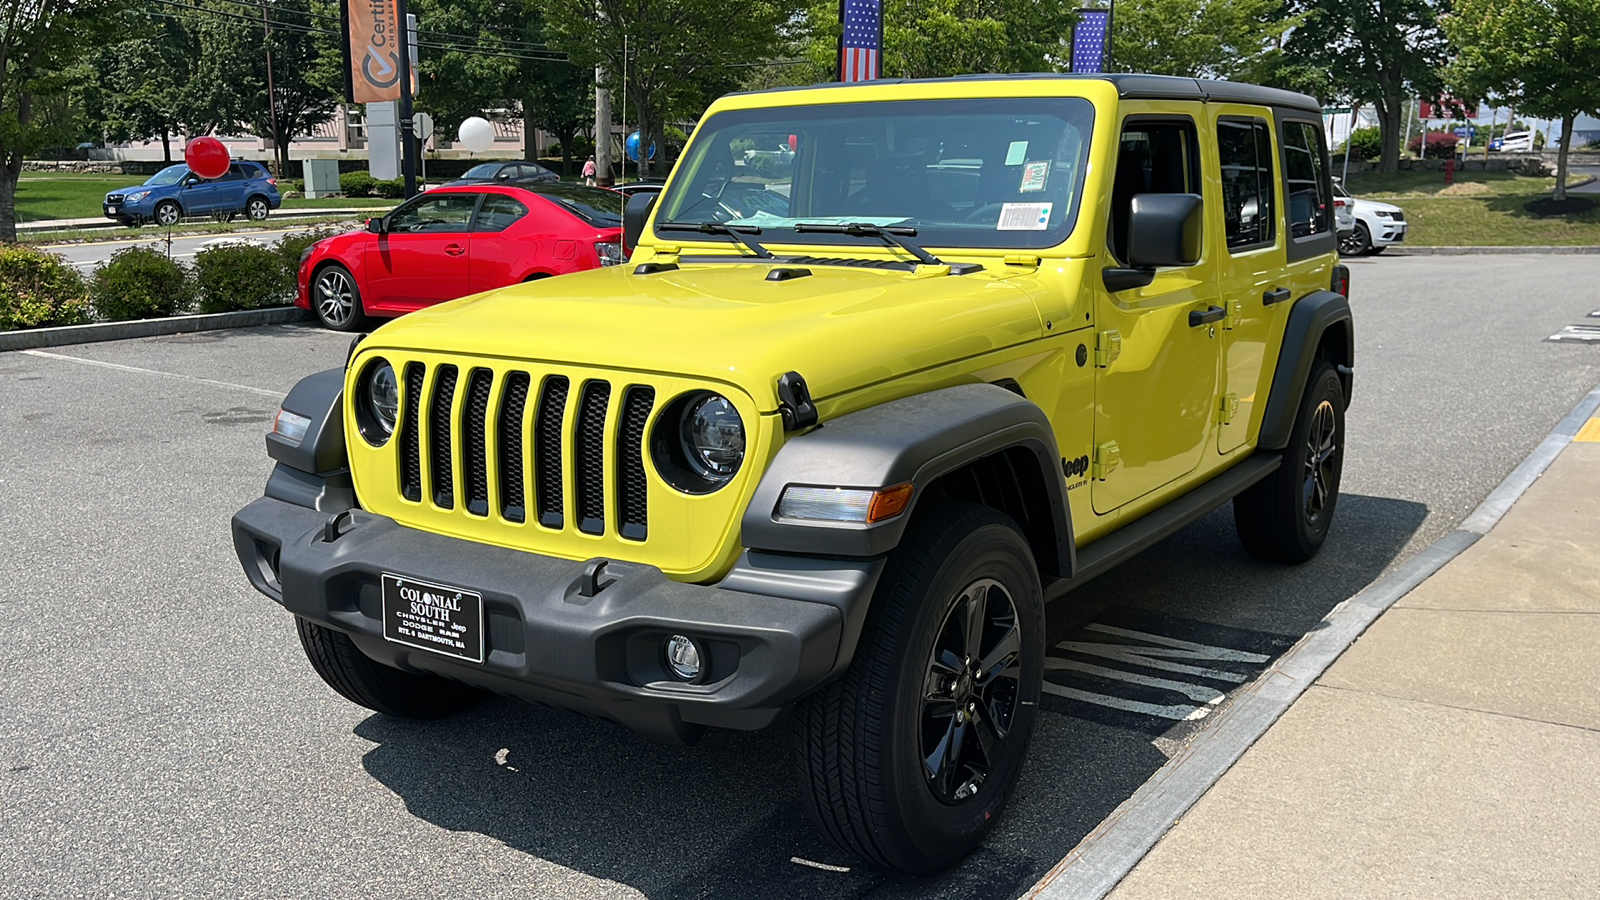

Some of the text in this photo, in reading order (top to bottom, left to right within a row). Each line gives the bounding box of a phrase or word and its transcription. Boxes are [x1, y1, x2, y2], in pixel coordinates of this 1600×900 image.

[400, 587, 461, 612] COLONIAL
[410, 601, 450, 621] SOUTH
[396, 611, 467, 633] CHRYSLER Jeep
[402, 620, 460, 638] DODGE RAM
[417, 631, 455, 648] DARTMOUTH,
[455, 640, 465, 649] MA
